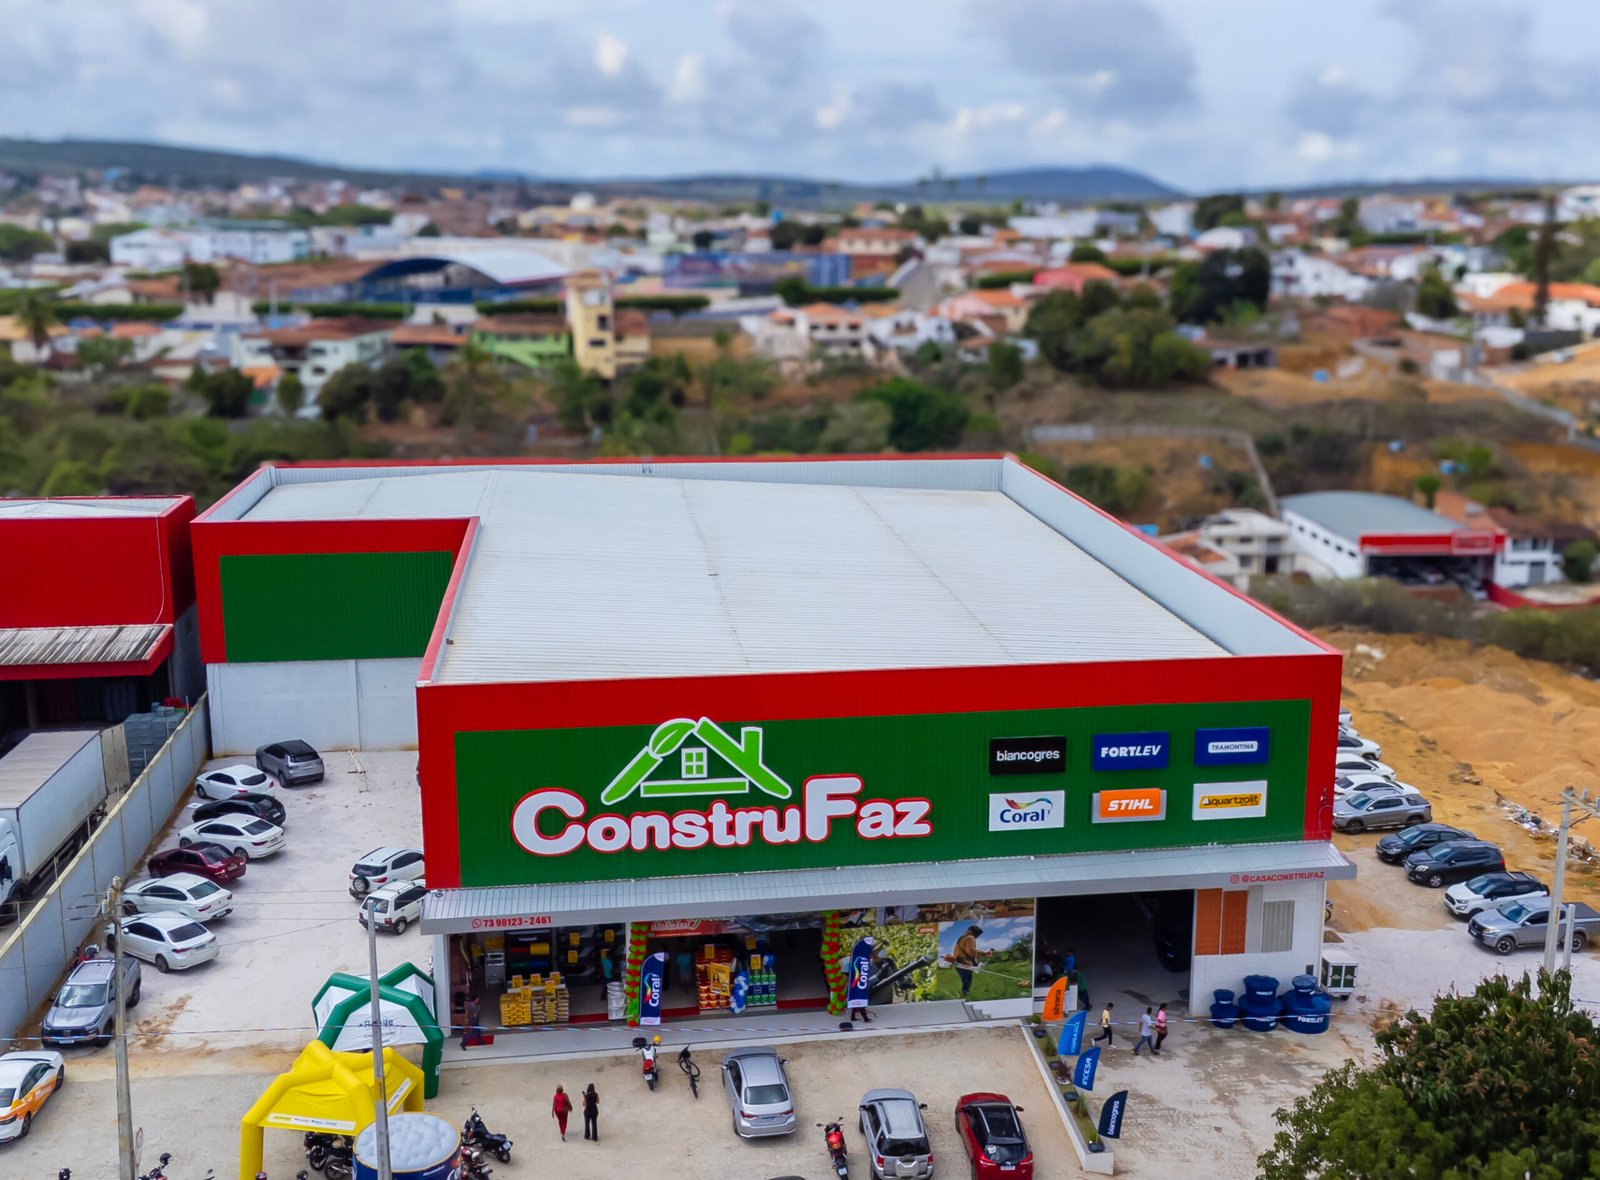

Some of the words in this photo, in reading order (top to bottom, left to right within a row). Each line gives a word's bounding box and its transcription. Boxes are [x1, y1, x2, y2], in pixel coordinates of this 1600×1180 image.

[996, 750, 1060, 762] biancogres
[1101, 745, 1161, 758] FORTLEV
[1108, 799, 1153, 811] STIHL
[1209, 795, 1259, 806] quartzolit
[512, 774, 932, 855] ConstruFaz
[999, 809, 1045, 823] Coral
[1241, 872, 1325, 883] @CASACONSTRUFAZ
[483, 919, 494, 927] 73
[857, 961, 869, 990] Coral
[649, 977, 661, 1007] Coral
[1081, 1057, 1093, 1086] INCESA
[1107, 1100, 1120, 1136] biancogres
